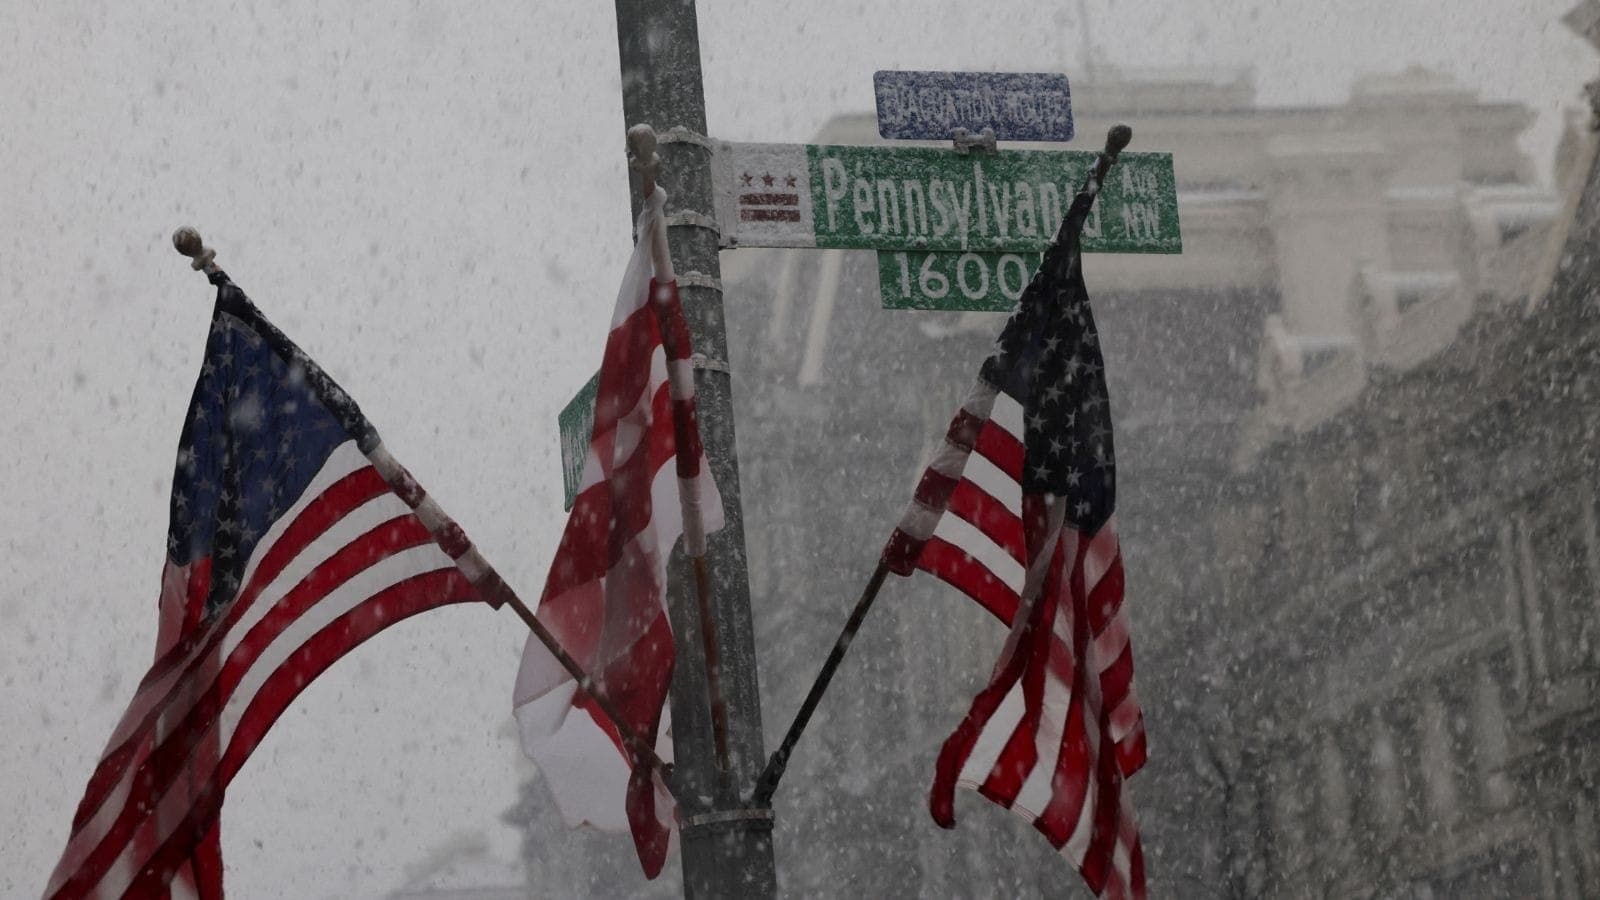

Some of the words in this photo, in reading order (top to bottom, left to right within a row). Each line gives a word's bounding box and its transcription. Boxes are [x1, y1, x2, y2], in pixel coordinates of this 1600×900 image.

[1121, 164, 1159, 199] Ave
[1121, 202, 1160, 240] NW
[893, 251, 1030, 301] 1600
